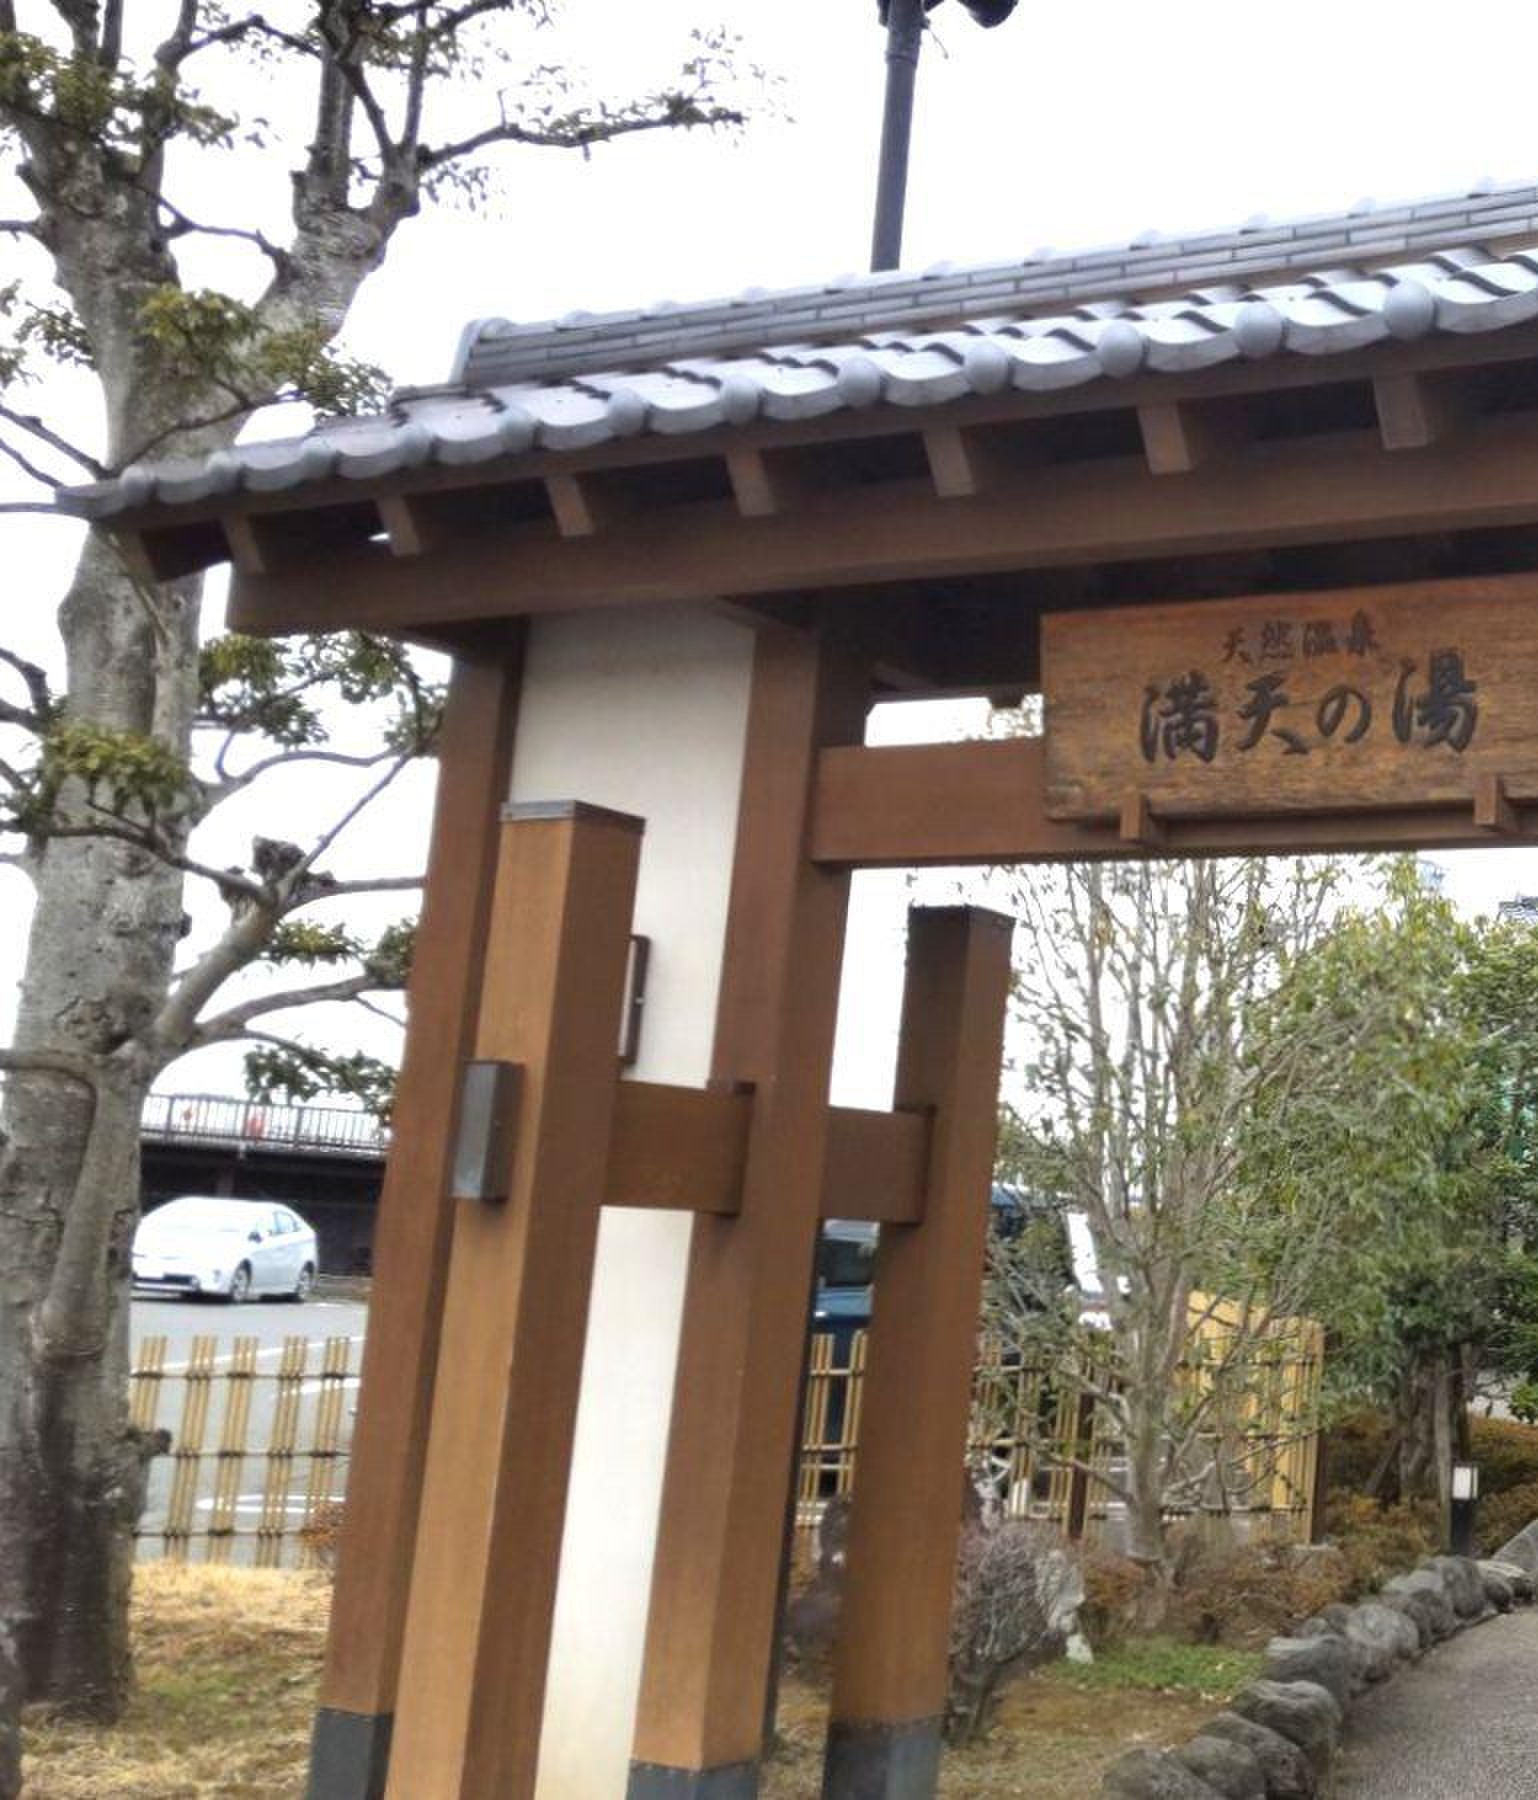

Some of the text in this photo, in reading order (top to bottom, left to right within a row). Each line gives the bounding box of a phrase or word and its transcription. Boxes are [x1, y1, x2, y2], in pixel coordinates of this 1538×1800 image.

[1221, 610, 1379, 664] 天然温泉
[1139, 647, 1478, 763] 満天の湯
